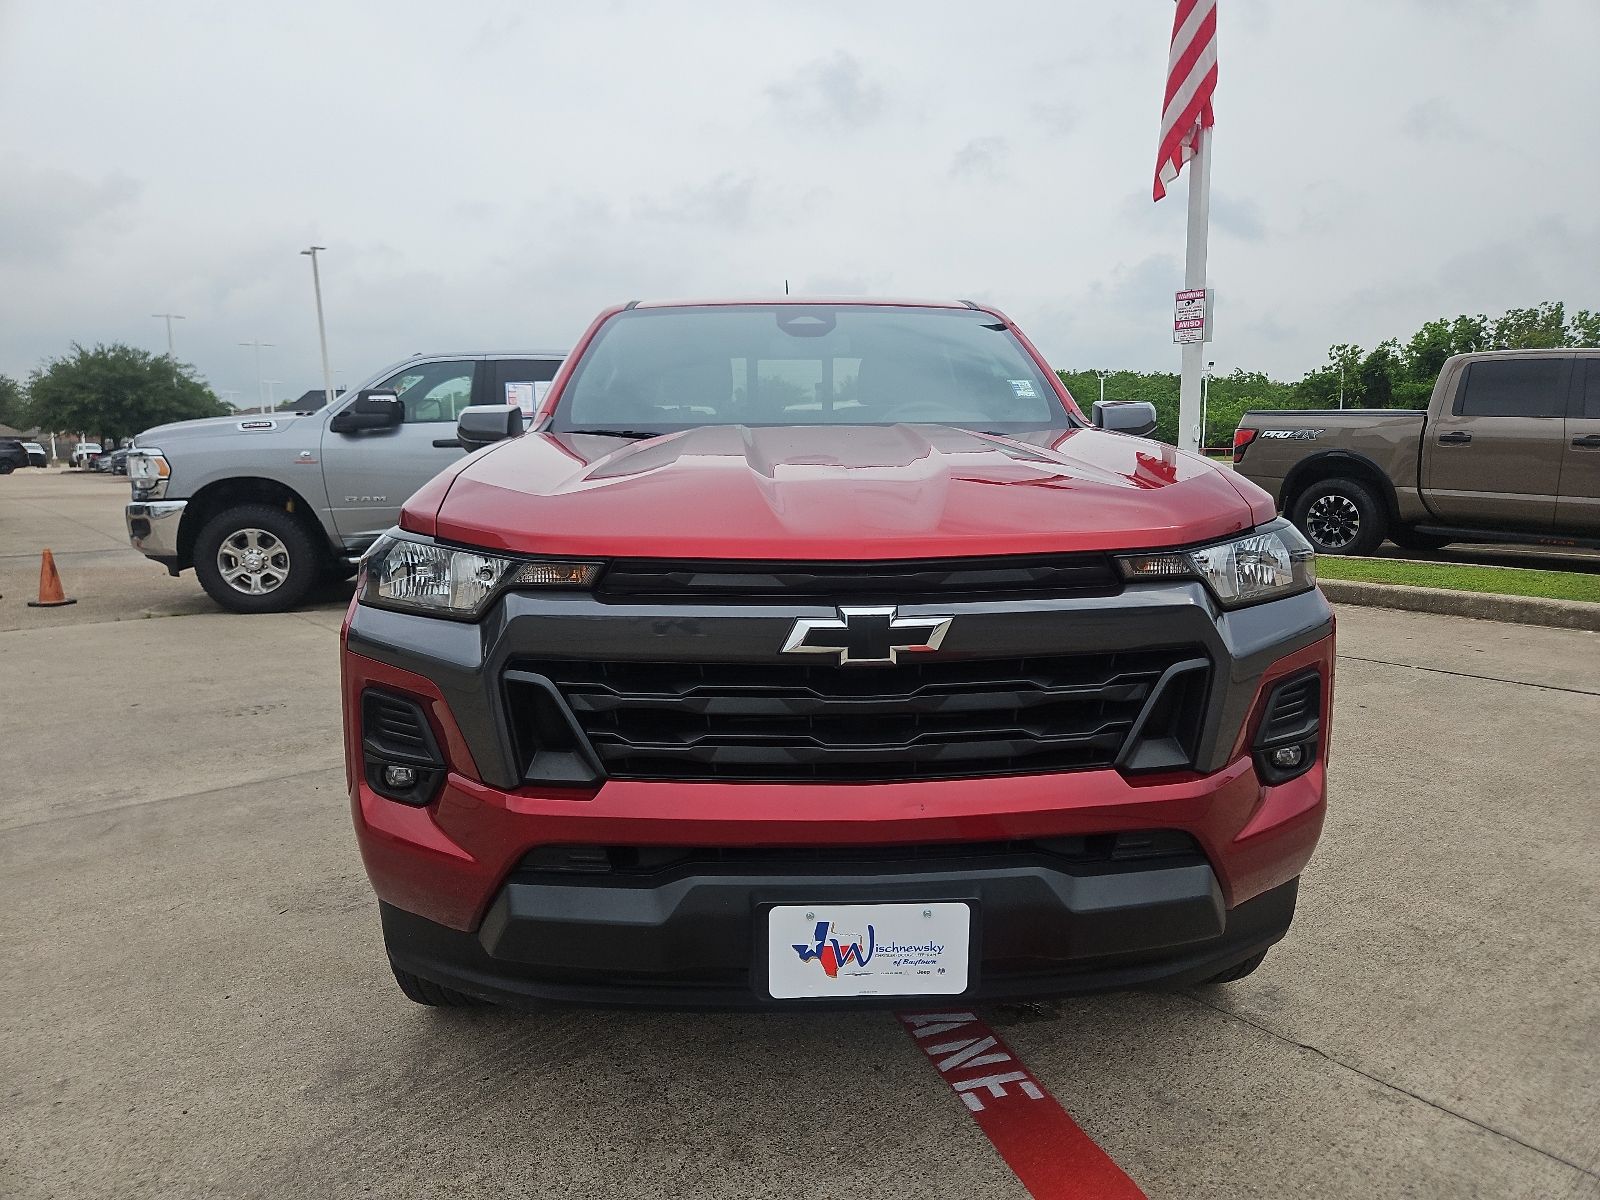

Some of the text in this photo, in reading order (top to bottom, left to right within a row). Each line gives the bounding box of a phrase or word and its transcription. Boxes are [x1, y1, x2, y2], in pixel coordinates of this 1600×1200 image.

[1177, 291, 1204, 300] WARNING
[1178, 320, 1200, 328] AVISO
[829, 924, 945, 968] Wischnewsky
[893, 958, 937, 967] of Baytown
[902, 1012, 1045, 1112] ANE
